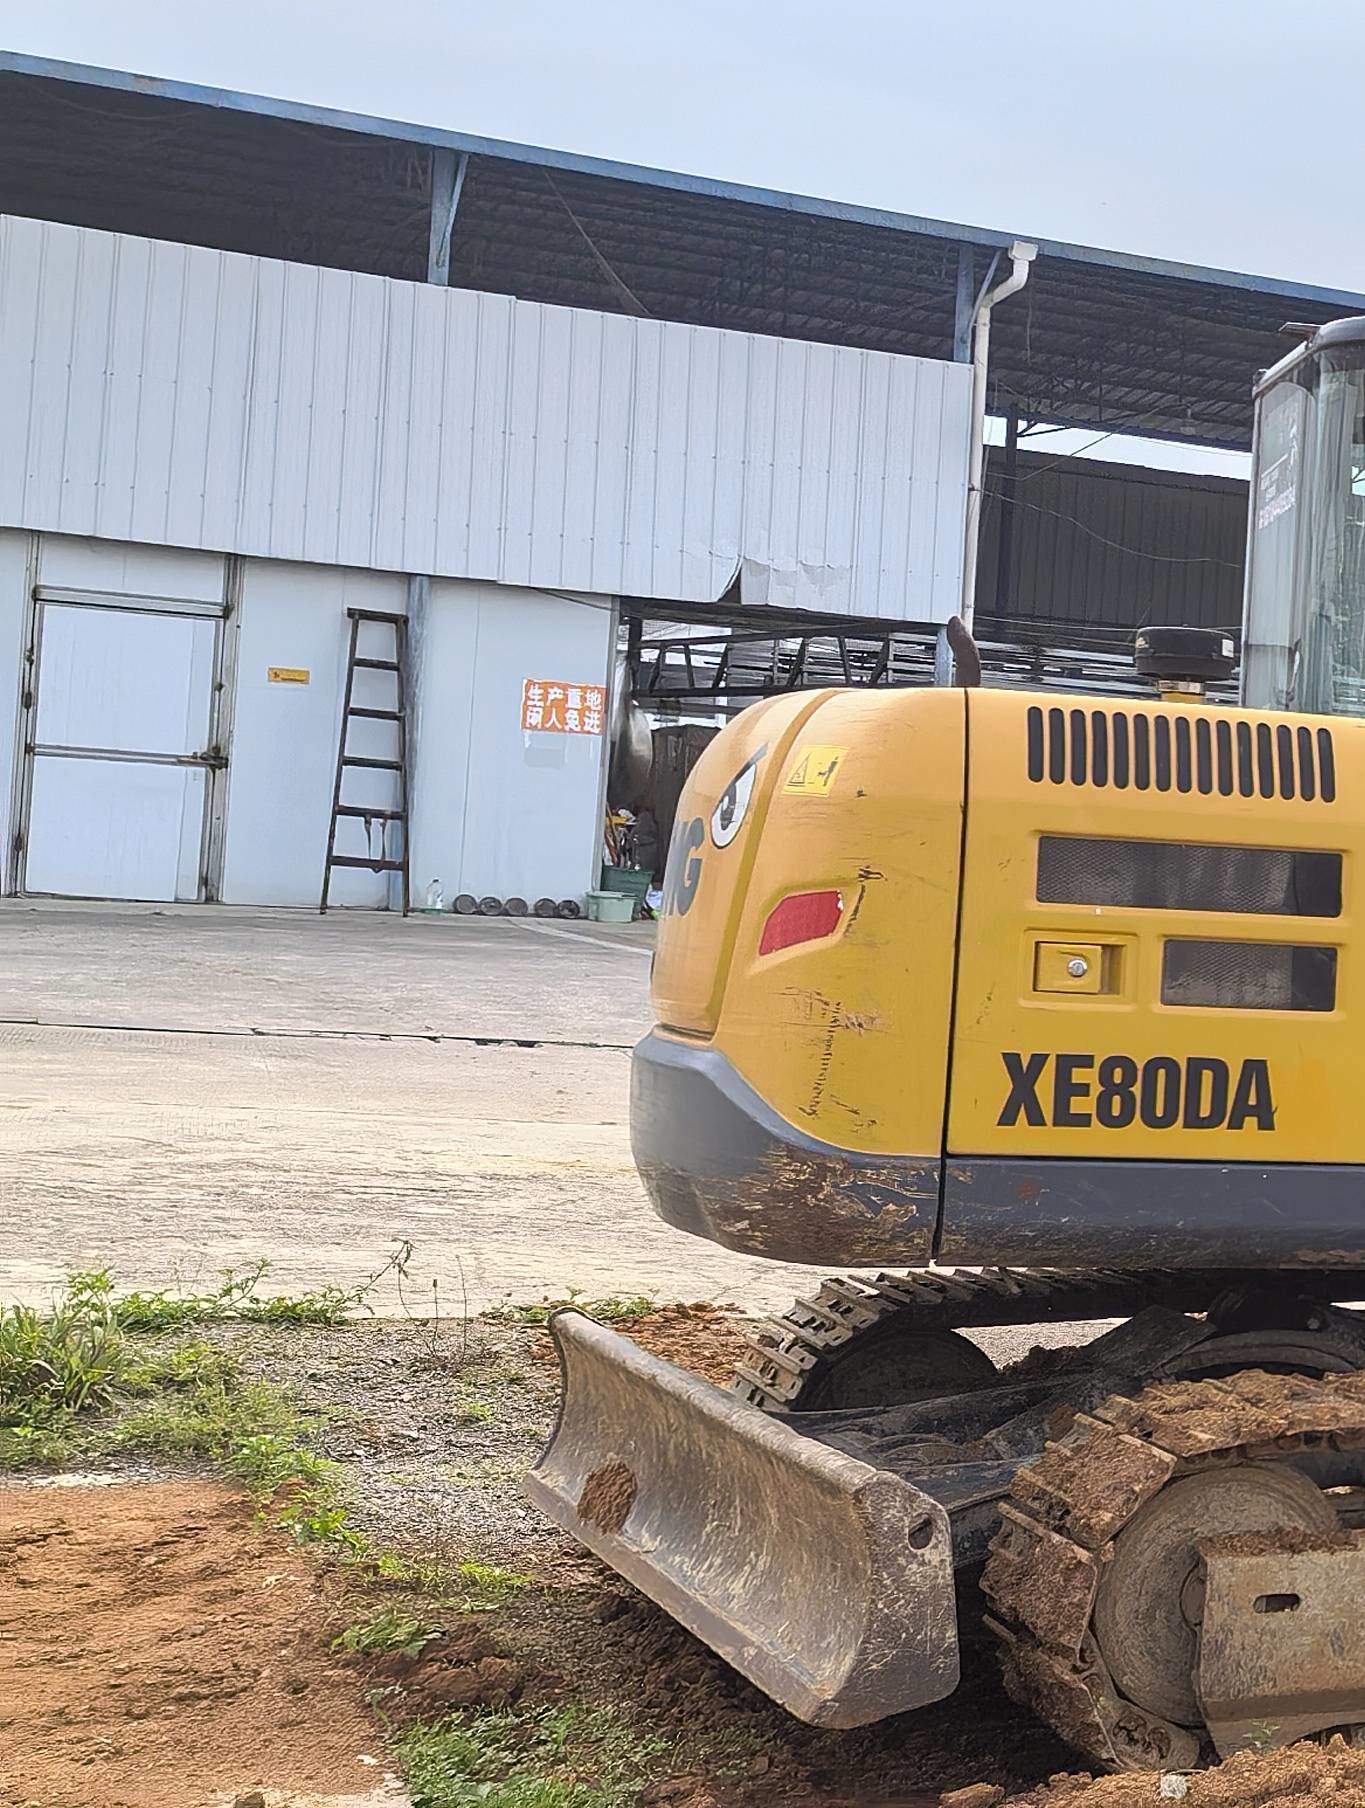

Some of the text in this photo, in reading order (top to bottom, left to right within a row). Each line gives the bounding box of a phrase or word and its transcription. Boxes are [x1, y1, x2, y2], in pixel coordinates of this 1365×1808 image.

[526, 683, 602, 711] 生产重地
[525, 706, 601, 733] 闲人免进
[996, 1052, 1277, 1131] XE80DA
